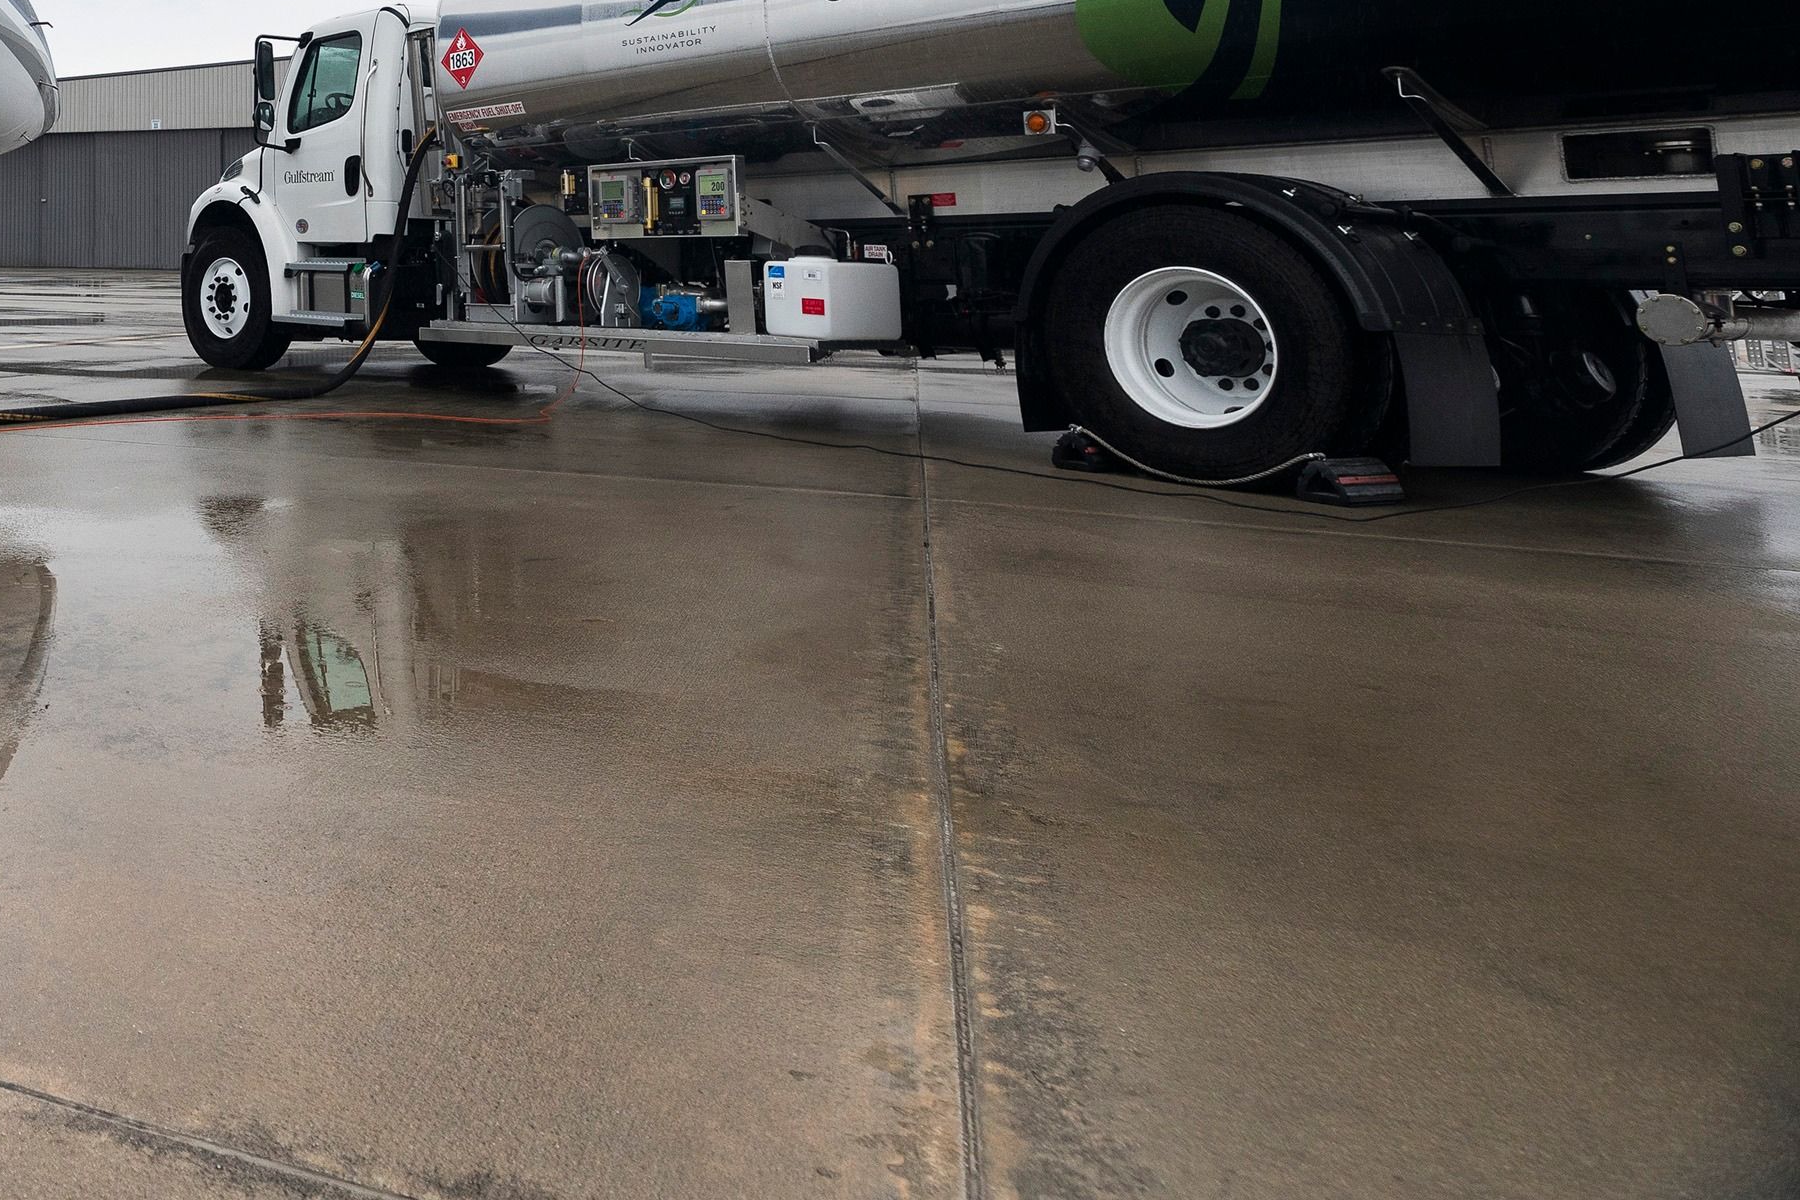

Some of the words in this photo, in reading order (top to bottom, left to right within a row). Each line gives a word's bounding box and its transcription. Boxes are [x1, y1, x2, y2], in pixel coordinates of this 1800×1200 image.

[622, 25, 717, 47] SUSTAINABILITY
[636, 38, 702, 54] INNOVATOR
[450, 50, 475, 69] 1863
[461, 76, 466, 84] 3
[448, 108, 481, 121] EMERGENCY
[481, 107, 496, 118] FUEL
[495, 103, 523, 115] SHUT-OFF
[284, 170, 334, 184] Gulfstream
[711, 181, 725, 192] 200
[772, 281, 782, 290] NSF
[351, 291, 365, 299] DIESEL
[530, 334, 647, 350] GARSITE
